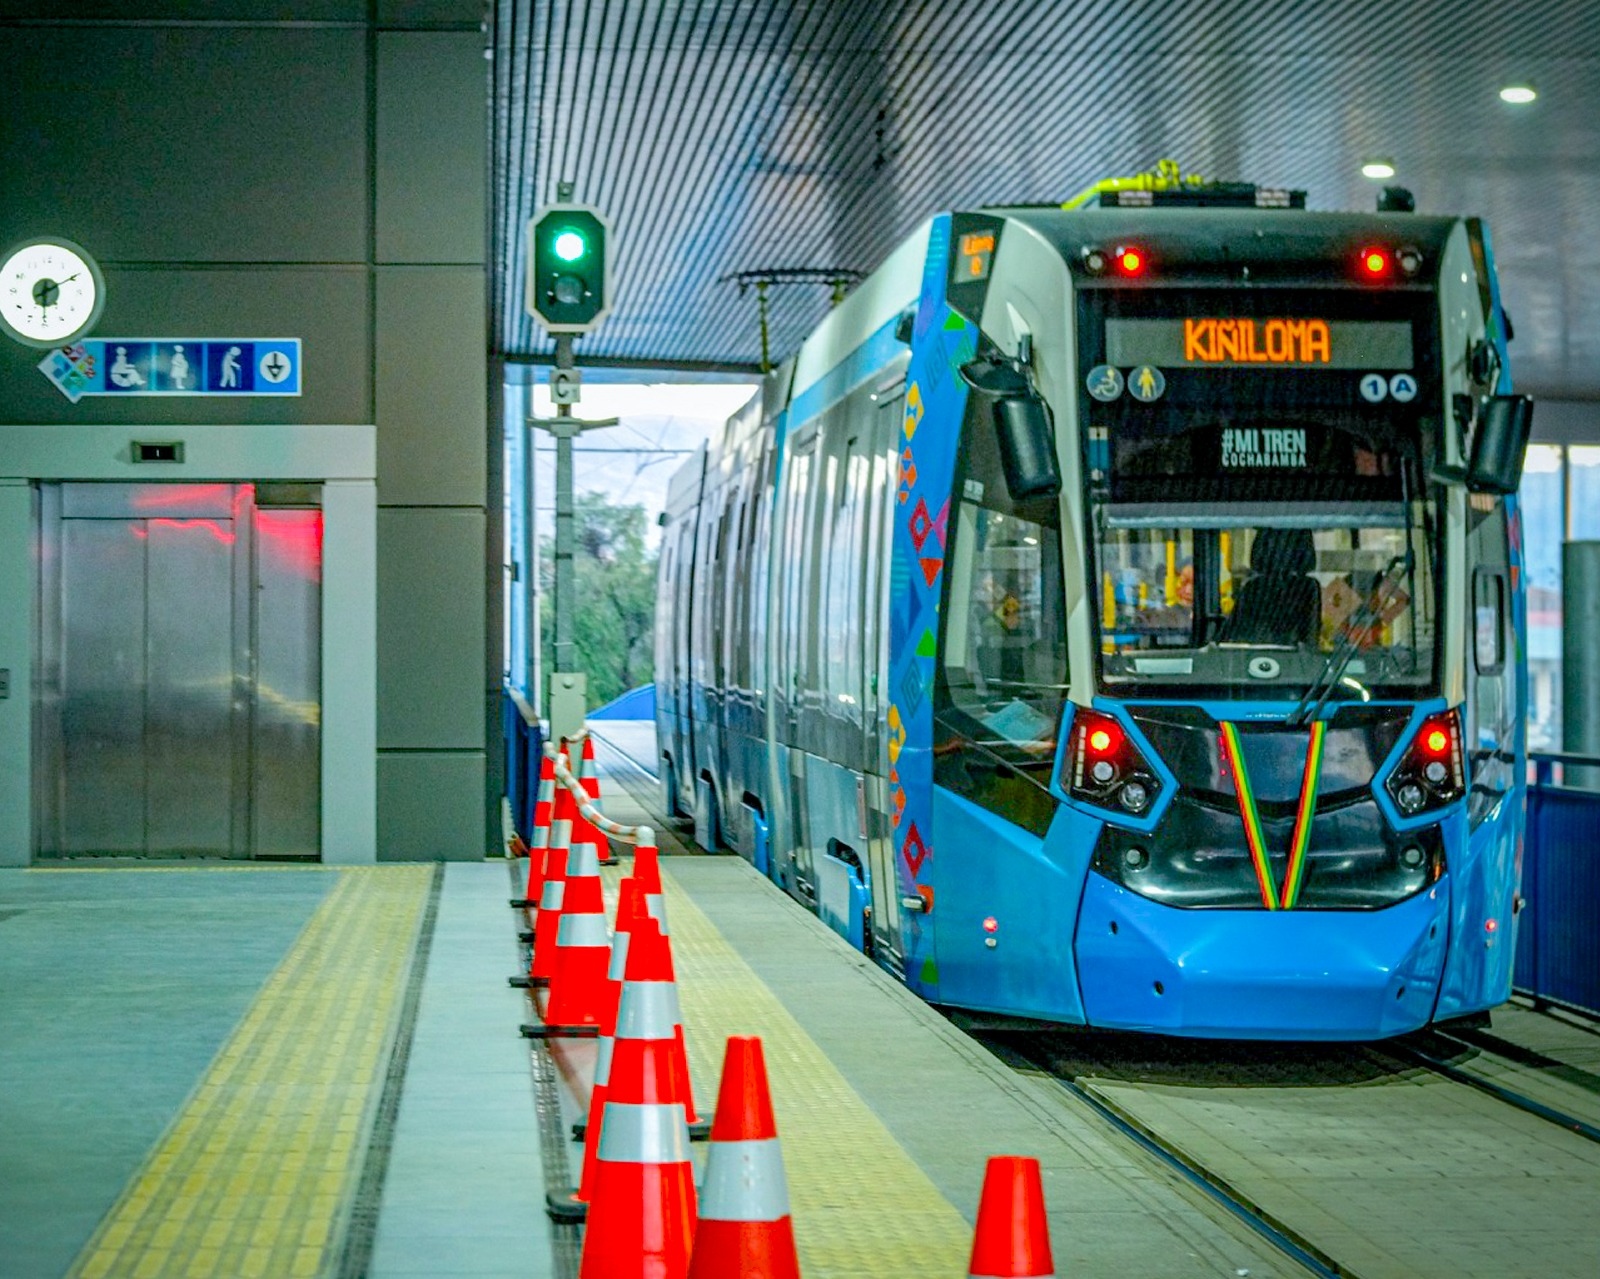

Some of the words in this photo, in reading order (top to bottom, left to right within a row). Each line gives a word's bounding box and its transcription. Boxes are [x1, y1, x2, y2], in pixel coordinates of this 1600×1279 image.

[1184, 318, 1330, 362] KIÑILOMA
[1395, 378, 1412, 393] A
[1222, 428, 1259, 454] #MI
[1261, 428, 1306, 454] TREN
[1222, 453, 1307, 468] COCHABAMBA
